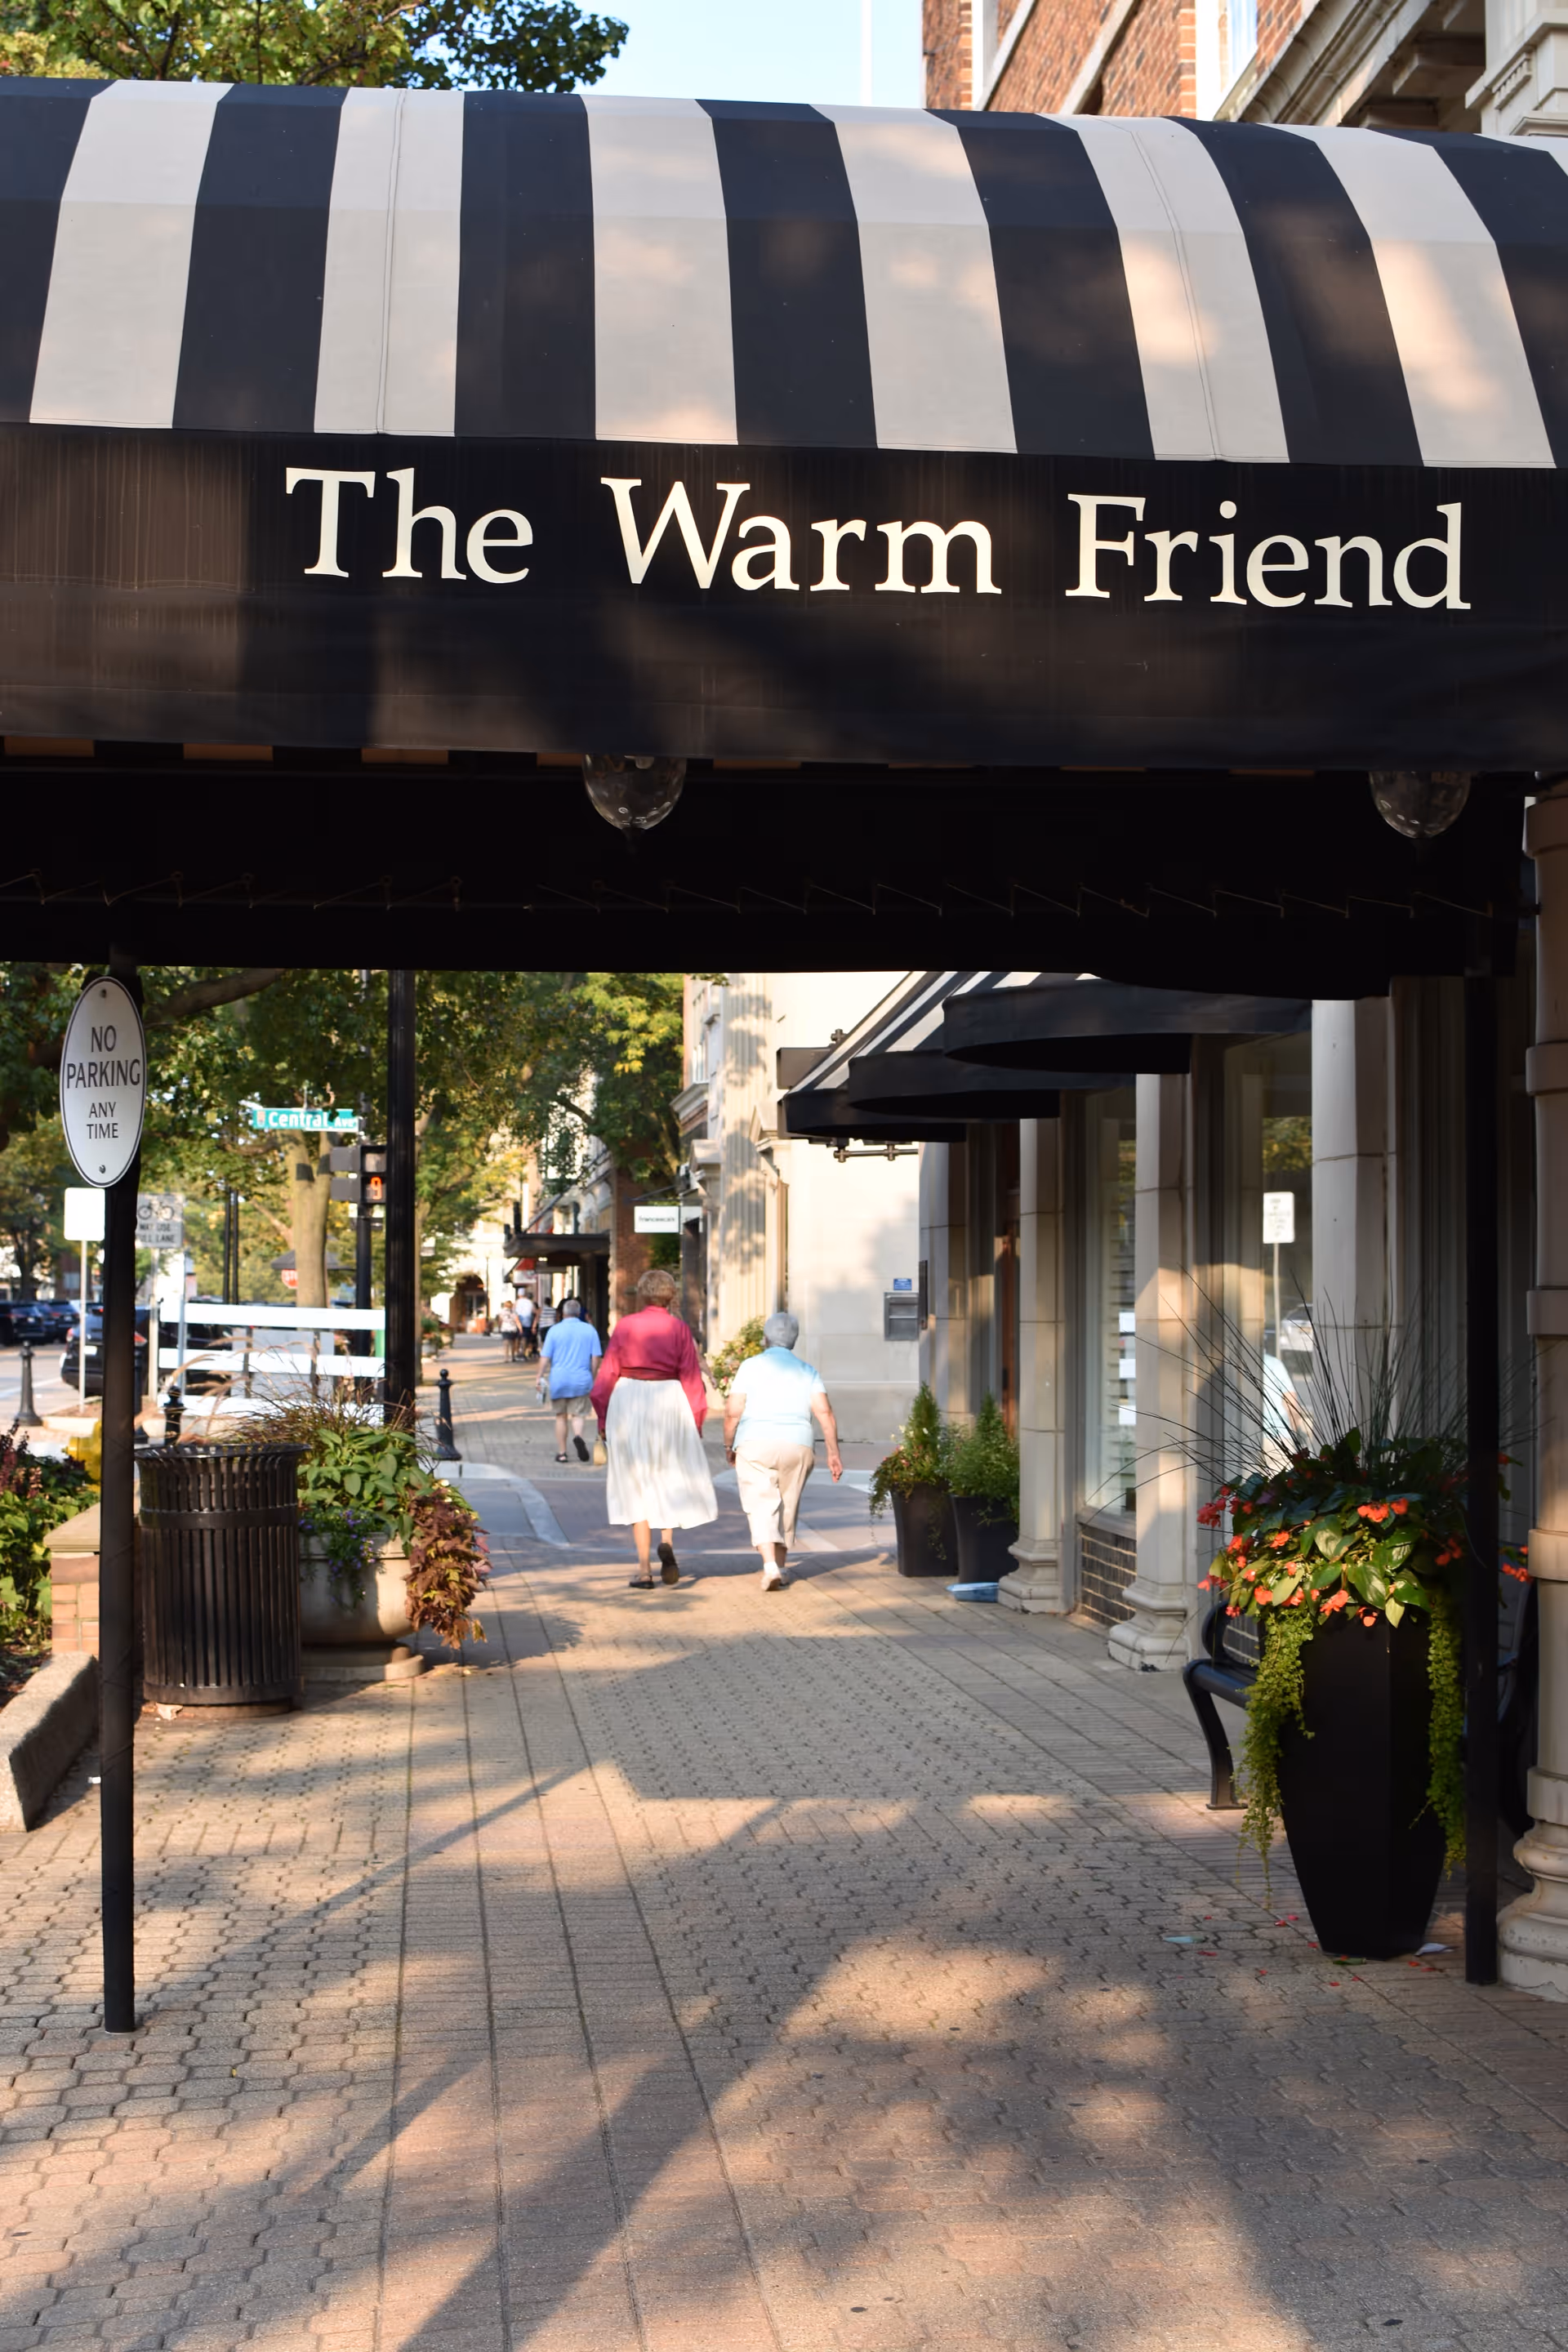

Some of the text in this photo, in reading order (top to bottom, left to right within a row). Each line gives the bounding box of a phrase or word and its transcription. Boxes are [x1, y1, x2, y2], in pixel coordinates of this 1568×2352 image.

[286, 466, 1472, 611] The Warm Friend
[91, 1025, 117, 1053] NO
[66, 1058, 140, 1089] PARKING
[88, 1101, 117, 1118] ANY
[268, 1111, 328, 1127] Central
[86, 1123, 119, 1139] TIME
[370, 1176, 382, 1200] 9
